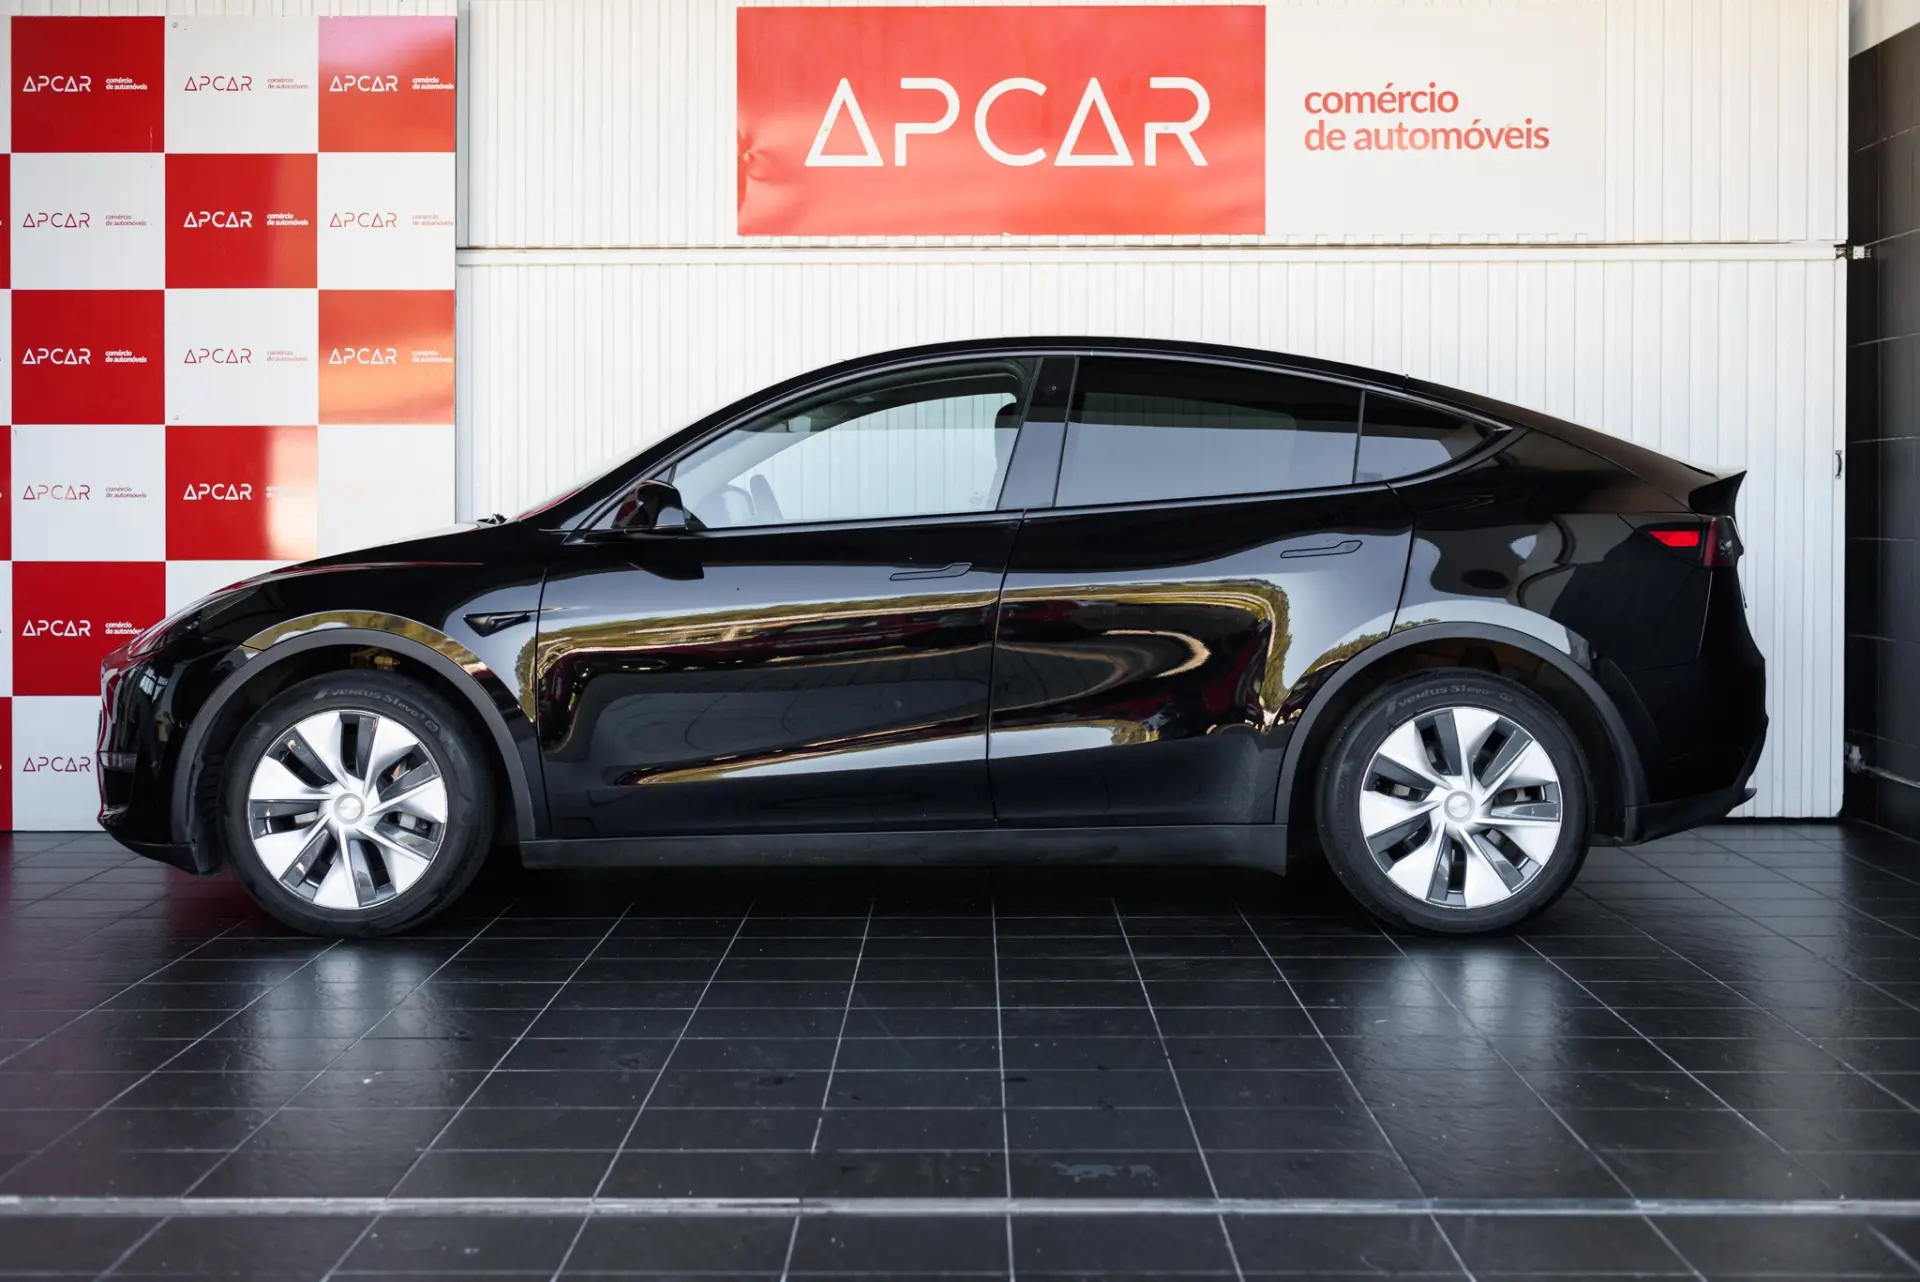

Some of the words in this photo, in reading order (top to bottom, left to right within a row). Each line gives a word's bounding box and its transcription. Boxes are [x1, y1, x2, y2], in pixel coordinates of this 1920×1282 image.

[23, 76, 91, 92] APCAR
[184, 76, 252, 91] APCAR
[329, 75, 398, 92] APCAR
[1304, 82, 1459, 114] comércio
[805, 78, 1209, 166] APCAR
[1305, 119, 1346, 151] de
[1354, 118, 1550, 151] automóveis
[23, 212, 90, 228] APCAR
[184, 211, 252, 228] APCAR
[330, 212, 397, 228] APCAR
[22, 348, 90, 365] APCAR
[184, 348, 251, 364] APCAR
[329, 348, 397, 365] APCAR
[23, 485, 90, 500] APCAR
[183, 483, 252, 500] APCAR
[22, 620, 91, 637] APCAR
[23, 757, 91, 772] APCAR
